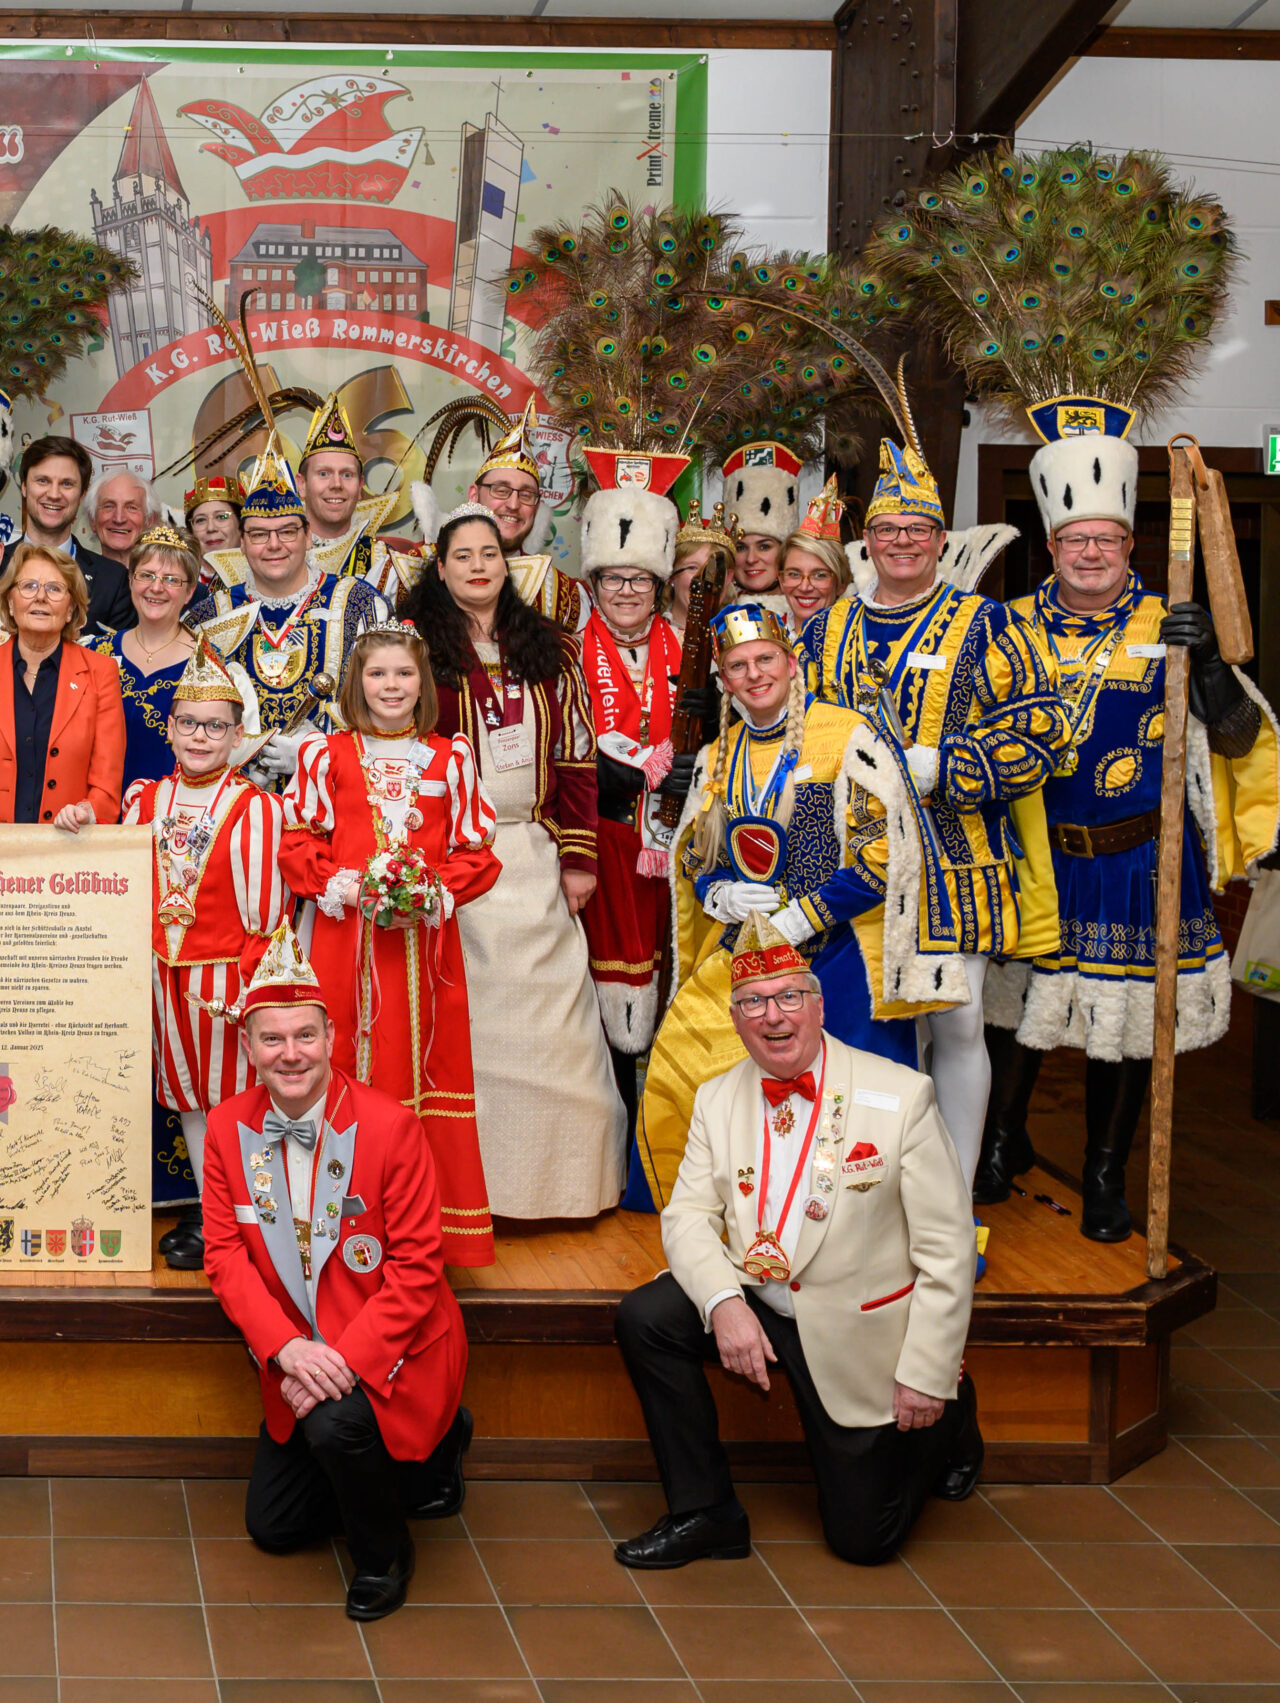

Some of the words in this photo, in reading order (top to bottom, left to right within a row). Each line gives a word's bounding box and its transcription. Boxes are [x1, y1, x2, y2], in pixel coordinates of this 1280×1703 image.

[145, 349, 198, 385] K.G.
[332, 318, 512, 400] Rommerskirchen
[83, 416, 100, 424] K.G.
[102, 413, 137, 422] Rut-Wieß
[503, 743, 520, 752] Zons
[49, 871, 129, 896] Gelöbnis
[772, 952, 793, 965] Senat
